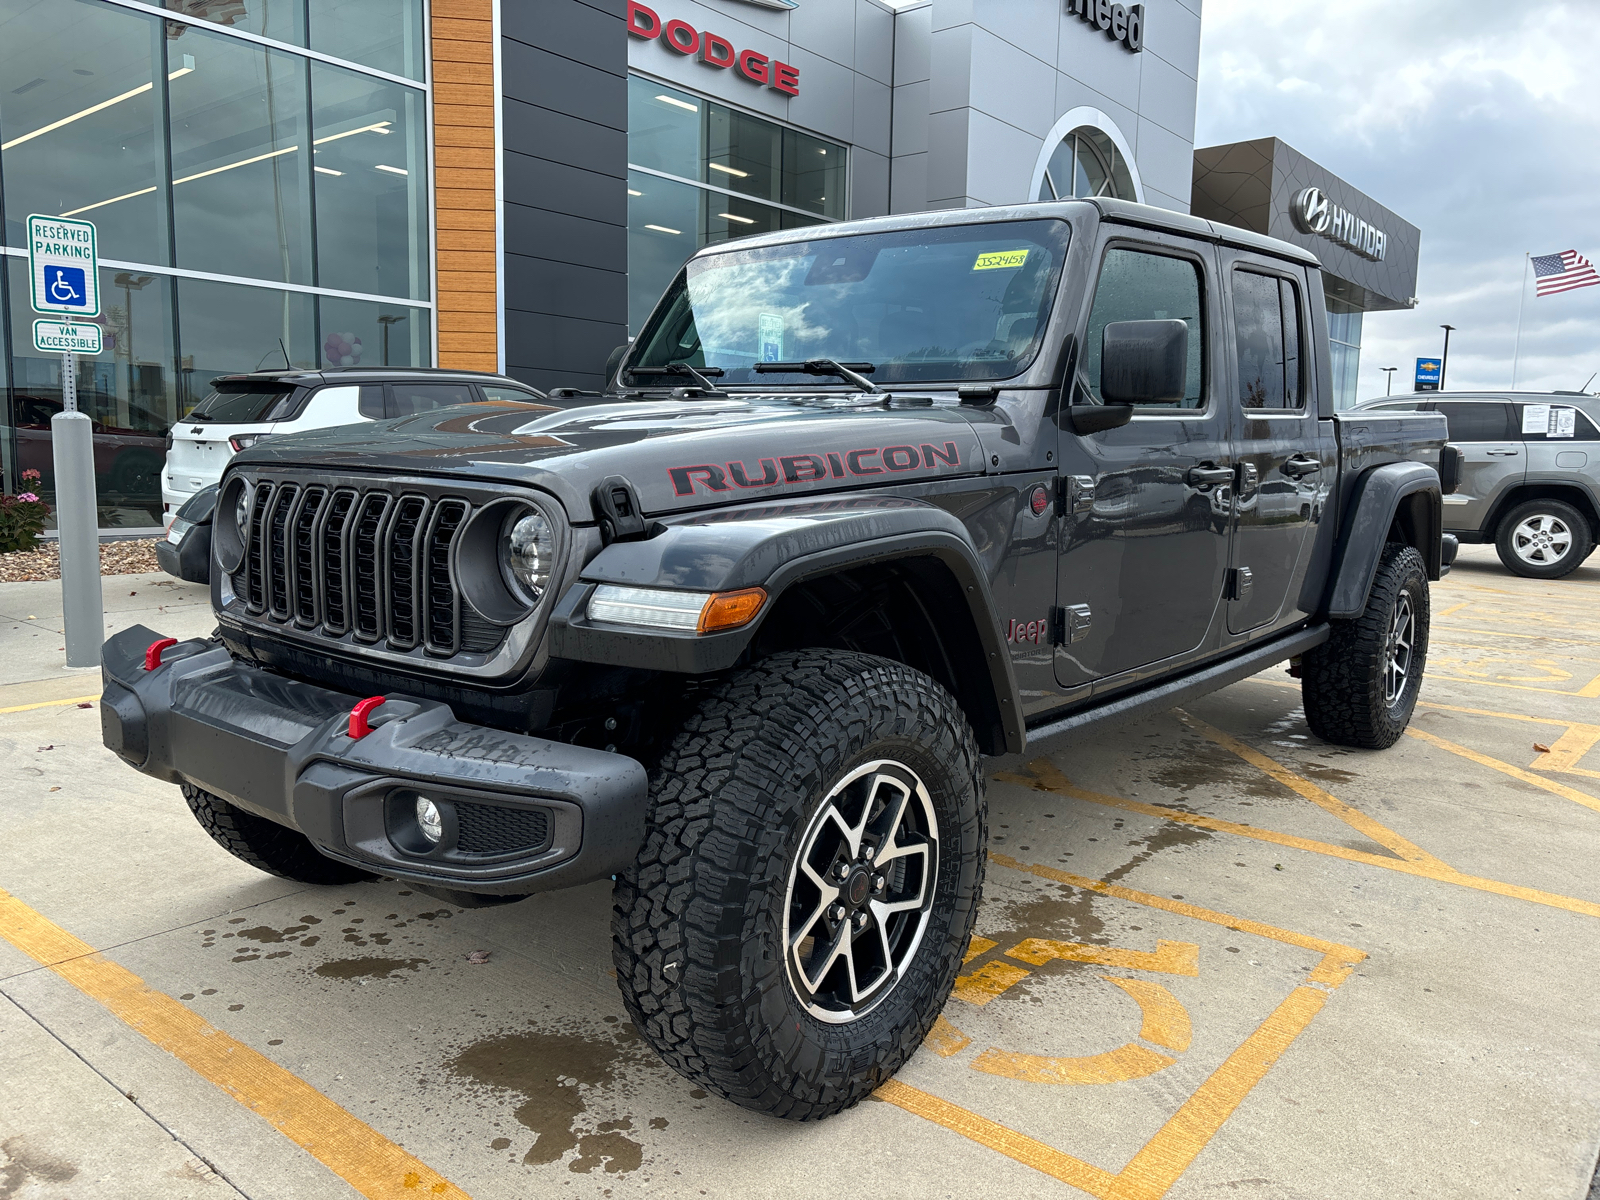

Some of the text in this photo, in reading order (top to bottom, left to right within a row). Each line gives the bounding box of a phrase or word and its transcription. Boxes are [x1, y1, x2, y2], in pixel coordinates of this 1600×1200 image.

[628, 0, 800, 96] DODGE
[35, 224, 89, 243] RESERVED
[1331, 204, 1387, 261] HYUNDAI
[35, 241, 91, 259] PARKING
[39, 336, 98, 349] ACCESSIBLE
[58, 326, 77, 337] VAN
[666, 441, 961, 497] RUBICON
[1007, 618, 1048, 645] Jeep
